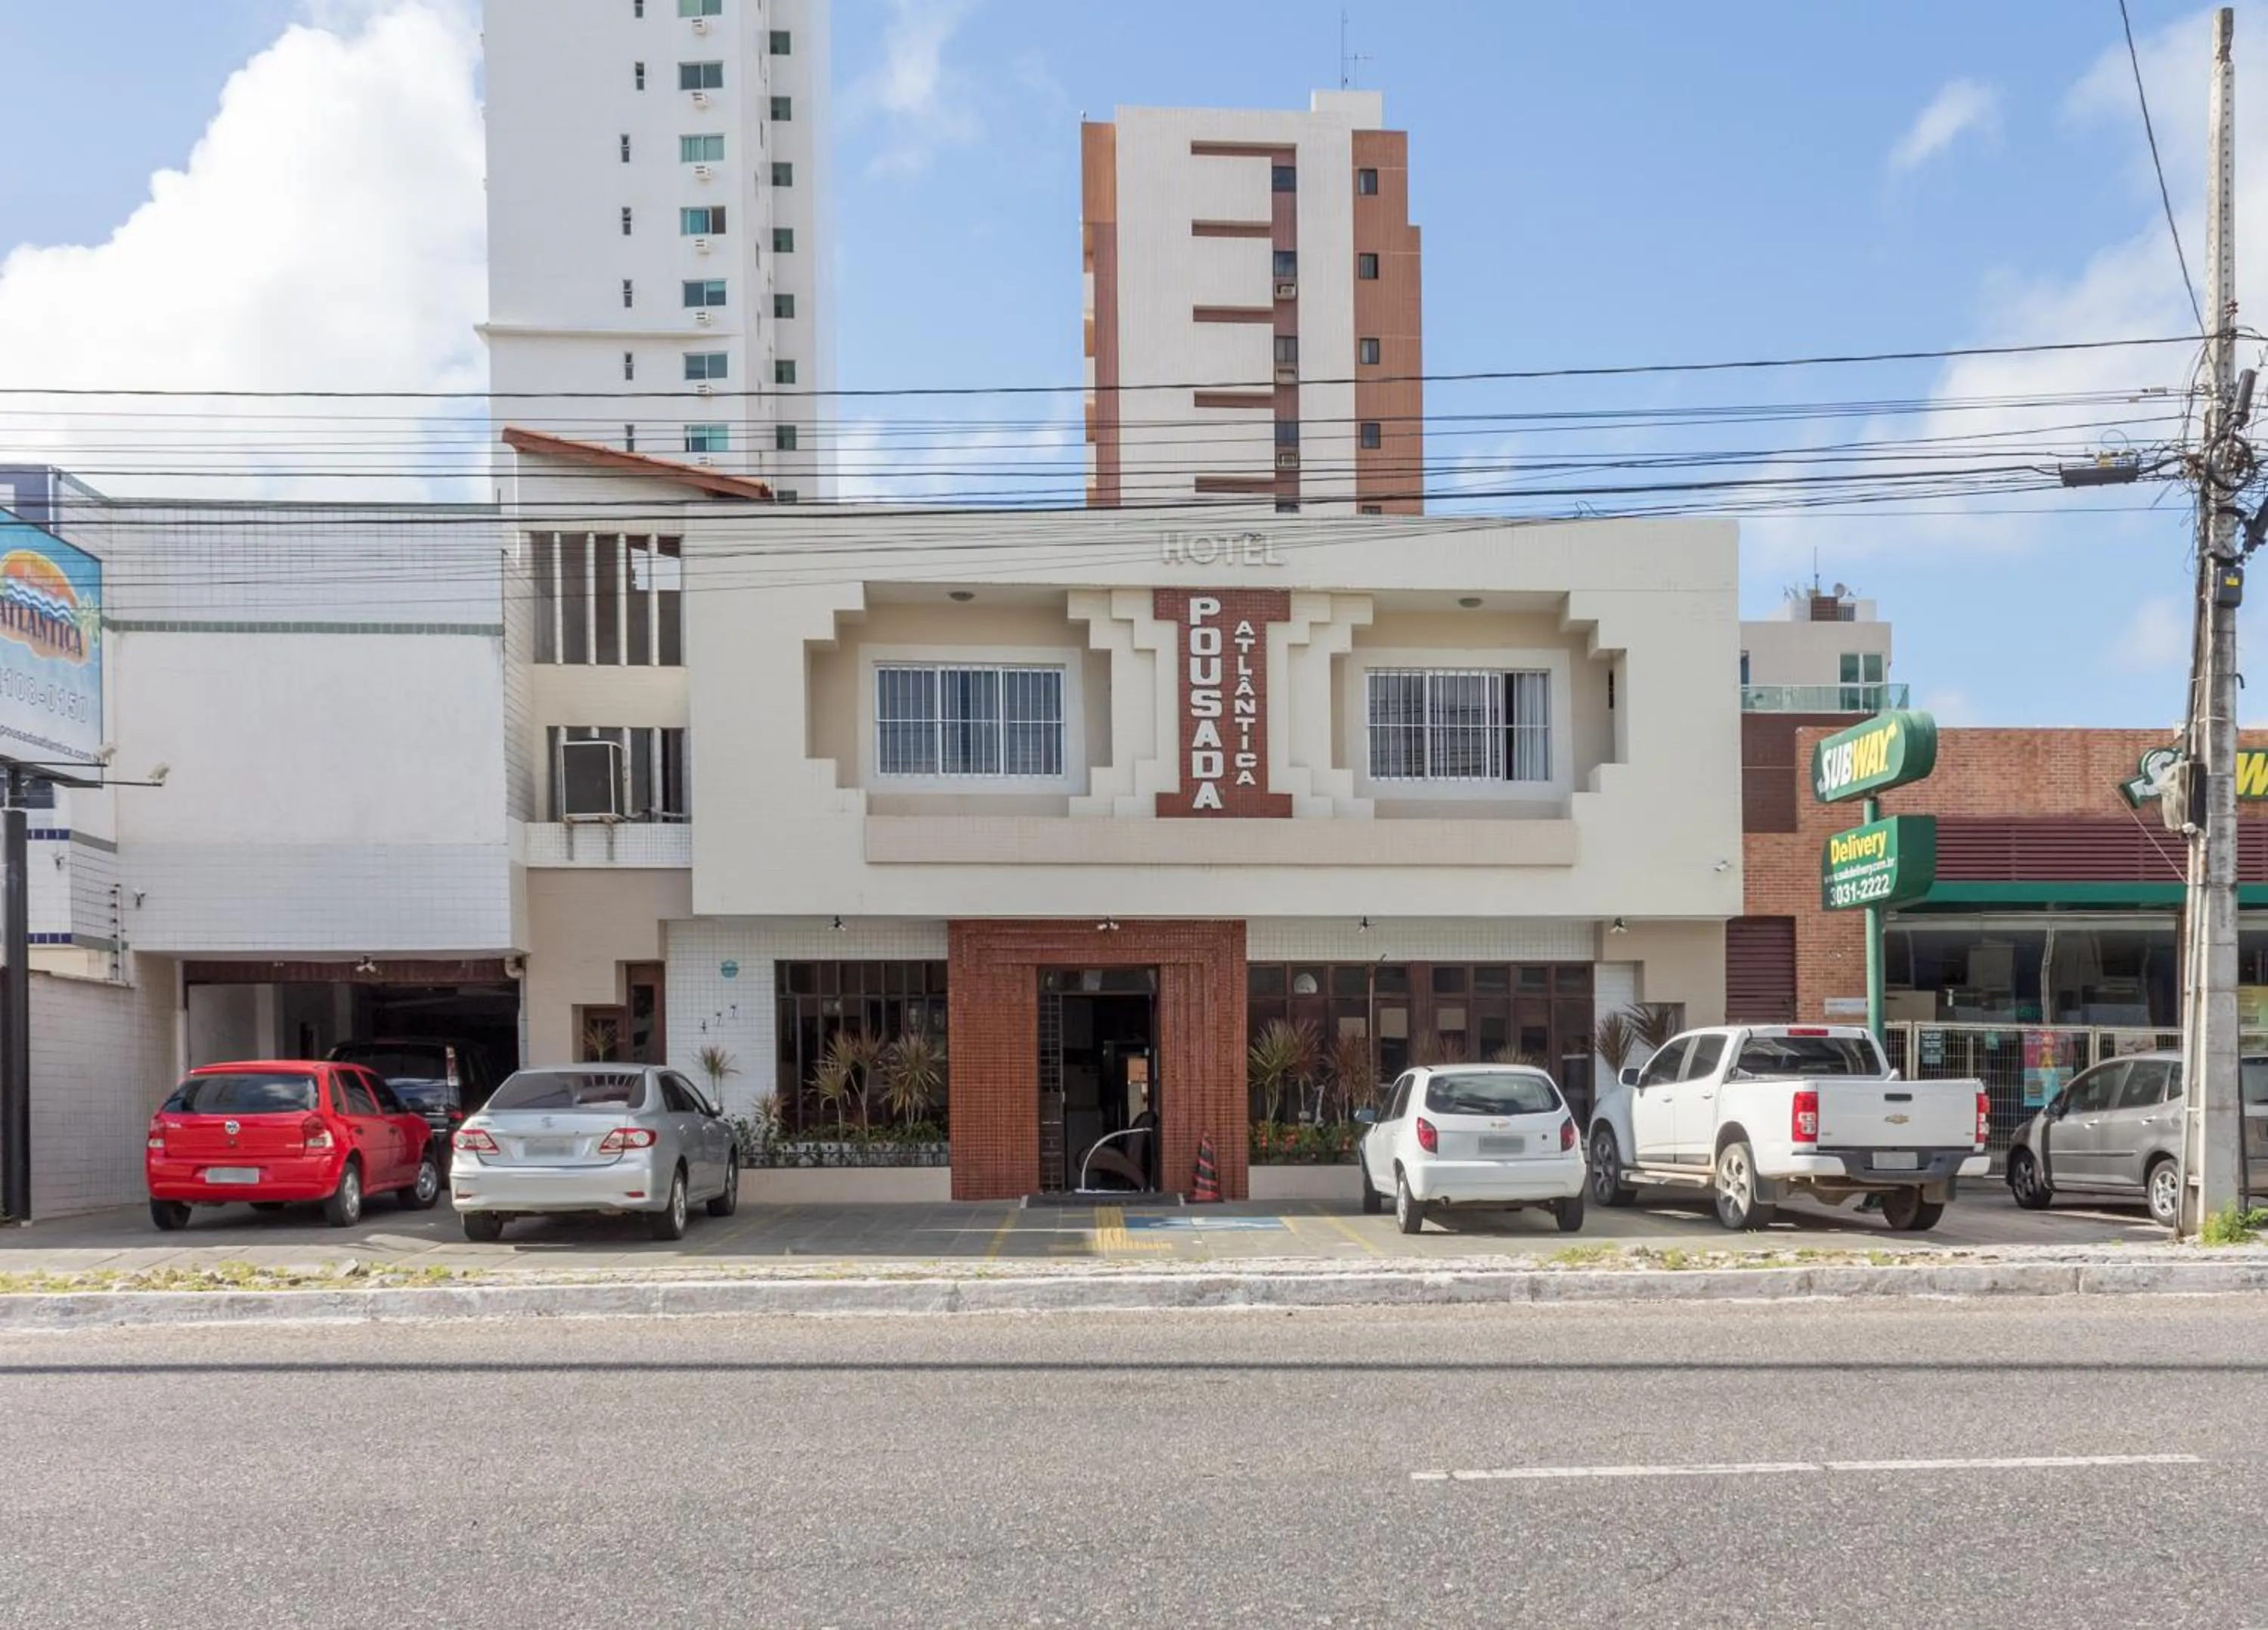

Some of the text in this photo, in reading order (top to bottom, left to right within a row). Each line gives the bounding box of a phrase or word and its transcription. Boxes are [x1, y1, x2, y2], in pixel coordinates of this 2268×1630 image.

[1161, 531, 1284, 566] HOTEL
[1189, 596, 1224, 810] POUSADA
[1234, 620, 1257, 786] ATLÂNTICA
[1817, 719, 1898, 794] SUBWAY
[1830, 831, 1887, 864] Delivery
[1830, 874, 1891, 906] 3031-2222
